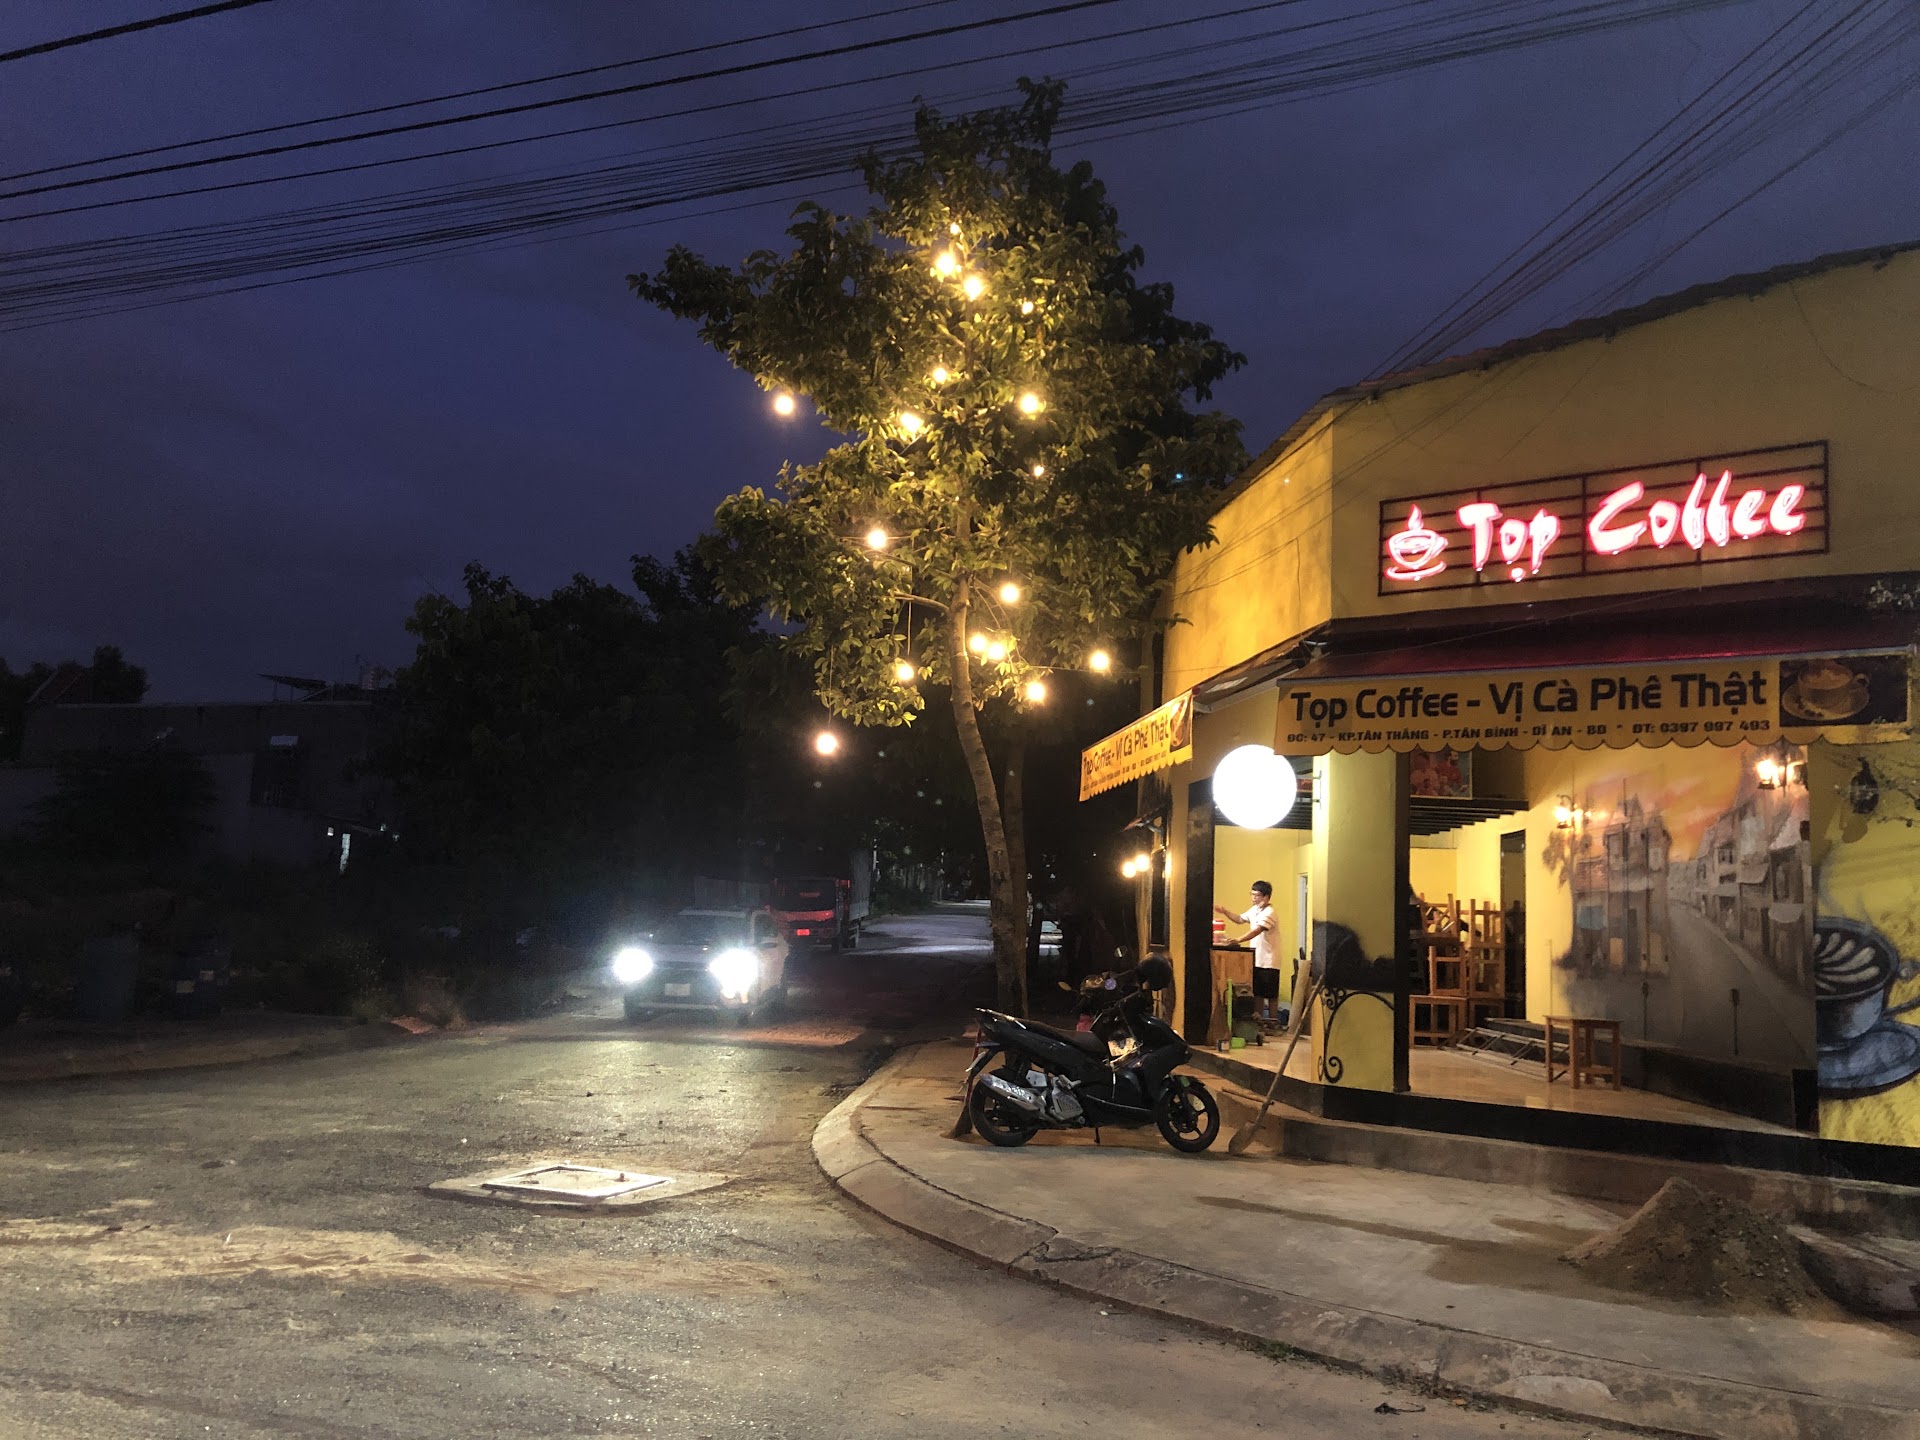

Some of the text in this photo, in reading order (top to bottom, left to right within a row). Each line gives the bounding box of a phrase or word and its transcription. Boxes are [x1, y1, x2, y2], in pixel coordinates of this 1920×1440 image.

[1587, 469, 1807, 555] Coffee
[1356, 687, 1458, 719] Coffee
[1489, 682, 1523, 722] Vị
[1533, 679, 1578, 712] Cà
[1590, 675, 1661, 711] Phê
[1671, 671, 1767, 715] Thật
[1311, 732, 1326, 742] 47
[1552, 725, 1572, 736] AN
